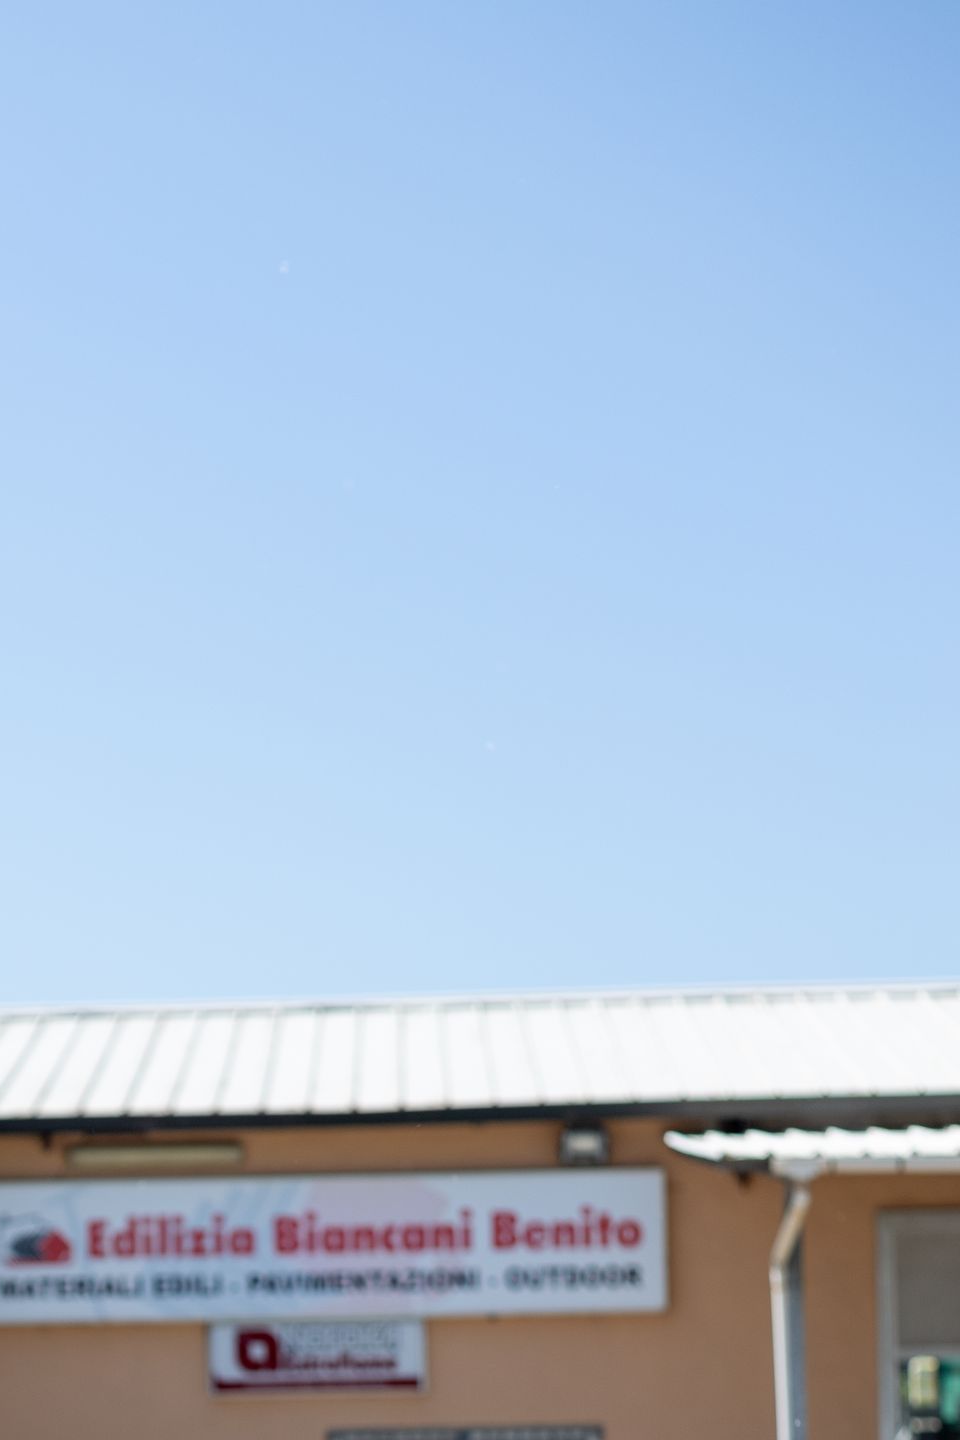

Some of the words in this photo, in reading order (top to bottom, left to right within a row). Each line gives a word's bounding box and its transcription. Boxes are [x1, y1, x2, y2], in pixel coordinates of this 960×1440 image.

[86, 1211, 256, 1259] Edilizia
[273, 1207, 474, 1257] Biancani
[492, 1205, 645, 1251] Benito
